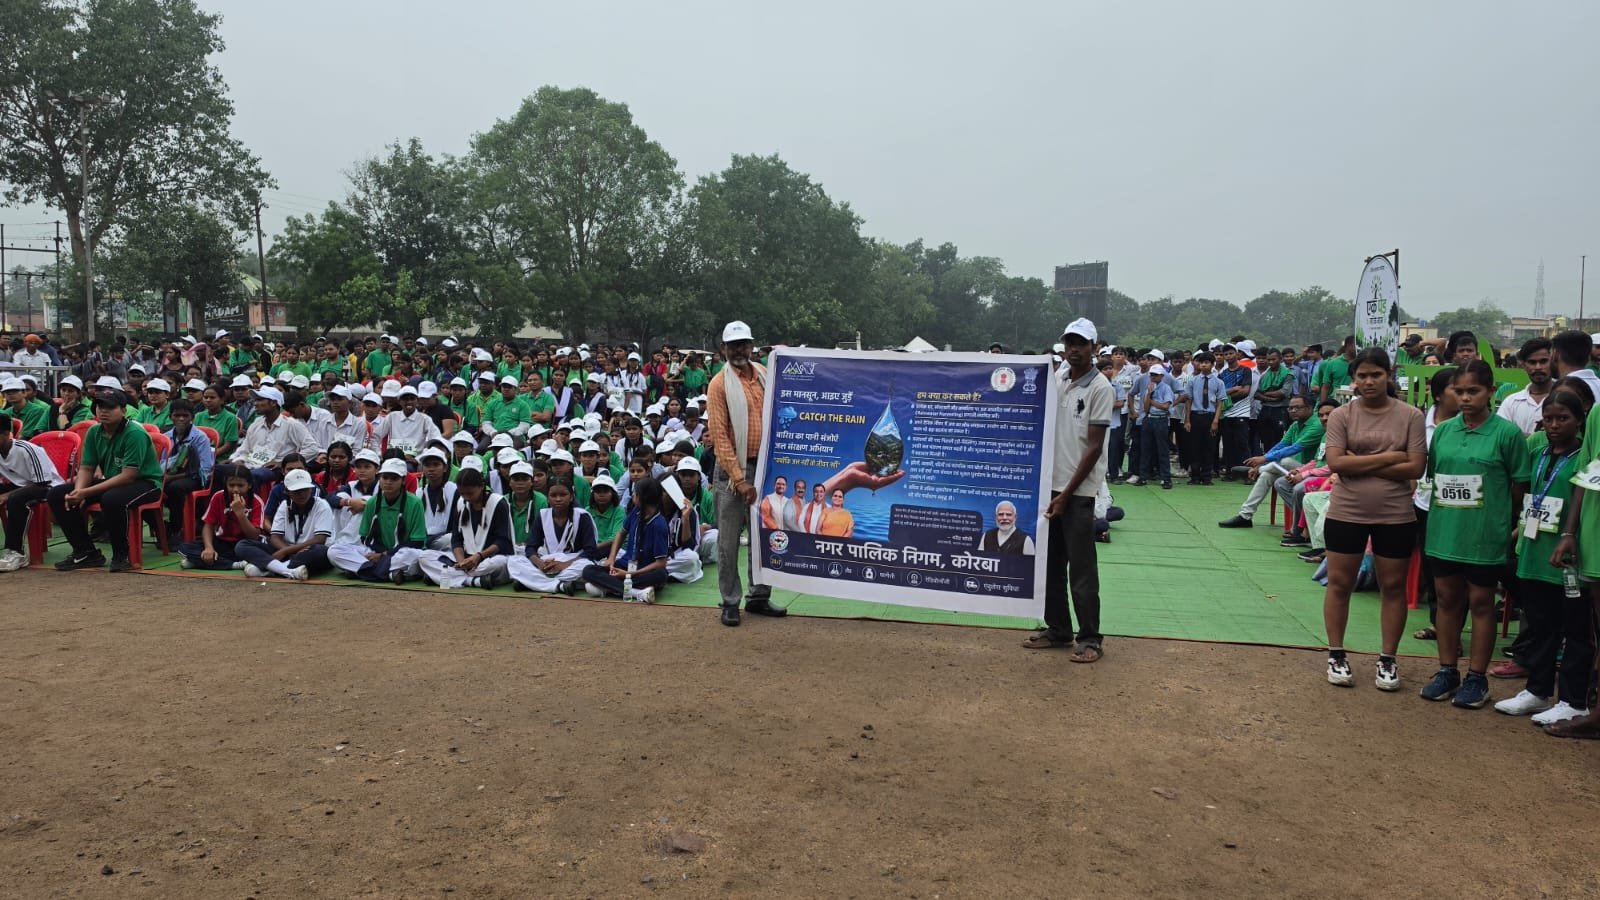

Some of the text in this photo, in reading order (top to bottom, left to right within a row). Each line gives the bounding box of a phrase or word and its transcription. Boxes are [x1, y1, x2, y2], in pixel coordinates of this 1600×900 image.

[780, 389, 792, 398] इस
[799, 411, 866, 425] CATCH THE RAIN
[776, 430, 794, 440] बारिश
[794, 431, 804, 440] का
[805, 431, 819, 441] पानी
[774, 442, 834, 454] जल संरक्षण अभियान
[1442, 487, 1471, 500] 0516
[814, 539, 845, 556] नगर
[846, 541, 899, 562] पालिक
[902, 545, 946, 569] निगम,
[950, 551, 1001, 573] कोरबा
